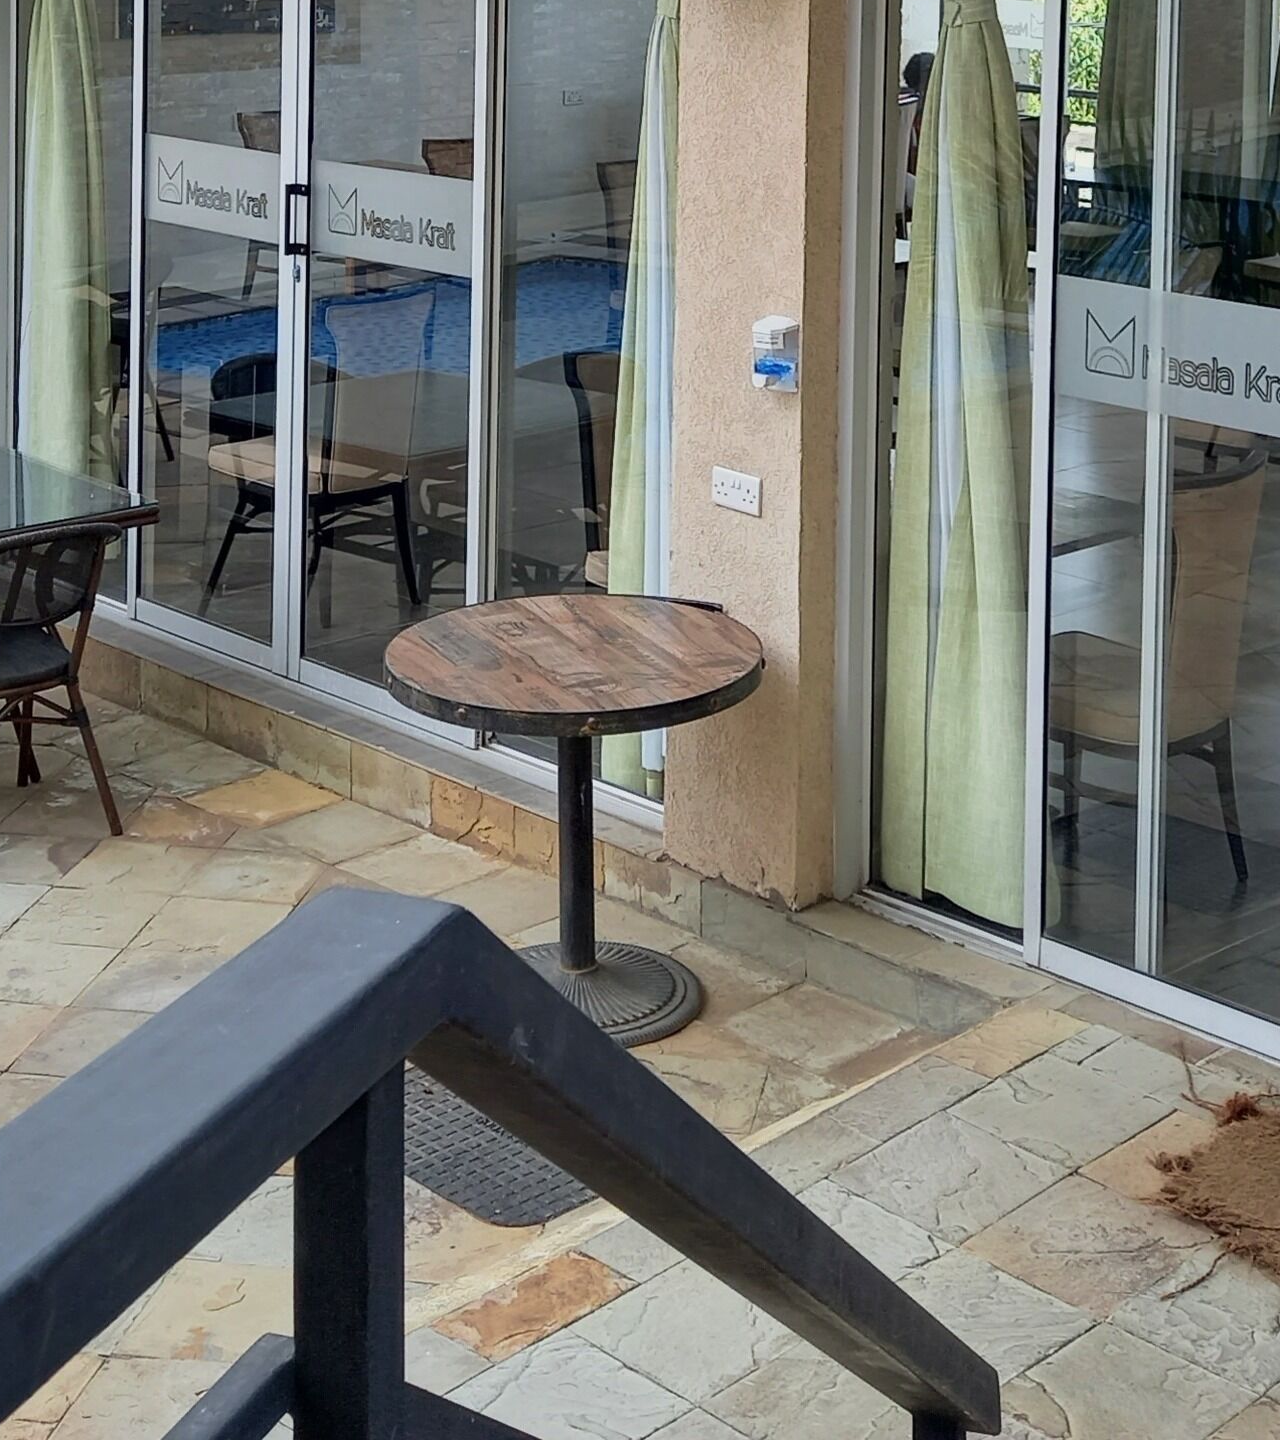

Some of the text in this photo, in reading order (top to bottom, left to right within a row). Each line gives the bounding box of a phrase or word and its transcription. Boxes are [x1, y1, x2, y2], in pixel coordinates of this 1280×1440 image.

[186, 179, 268, 220] Masala Kraft
[361, 208, 456, 251] Masala Kraft
